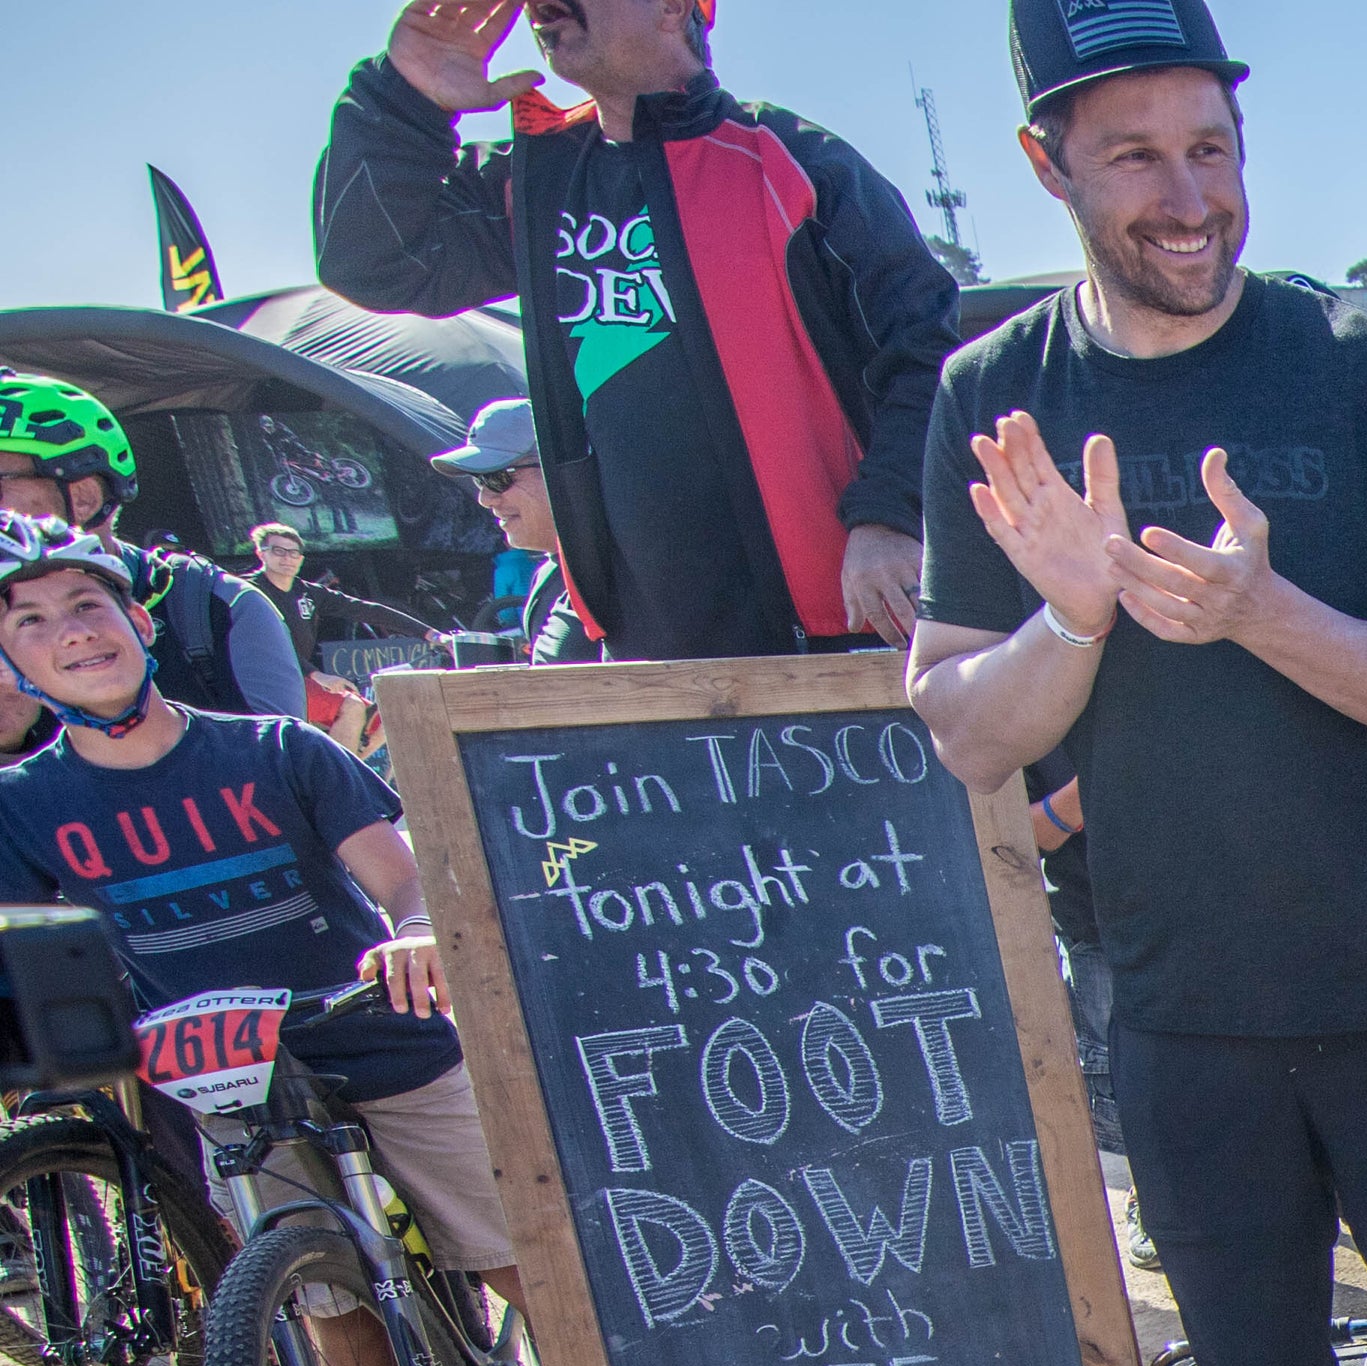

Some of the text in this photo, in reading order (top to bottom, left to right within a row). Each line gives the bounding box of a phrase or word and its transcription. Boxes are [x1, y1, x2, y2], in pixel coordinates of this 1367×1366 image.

[504, 721, 928, 840] Join TASCO
[56, 782, 282, 880] QUIK
[113, 870, 304, 929] SILVER
[545, 820, 923, 948] tonight at
[636, 926, 947, 1013] 4:30 for
[140, 1008, 266, 1083] 2614
[197, 1075, 259, 1095] SUBARU
[575, 988, 982, 1173] FOOT
[604, 1138, 1056, 1328] DOWN
[756, 1289, 934, 1360] with
